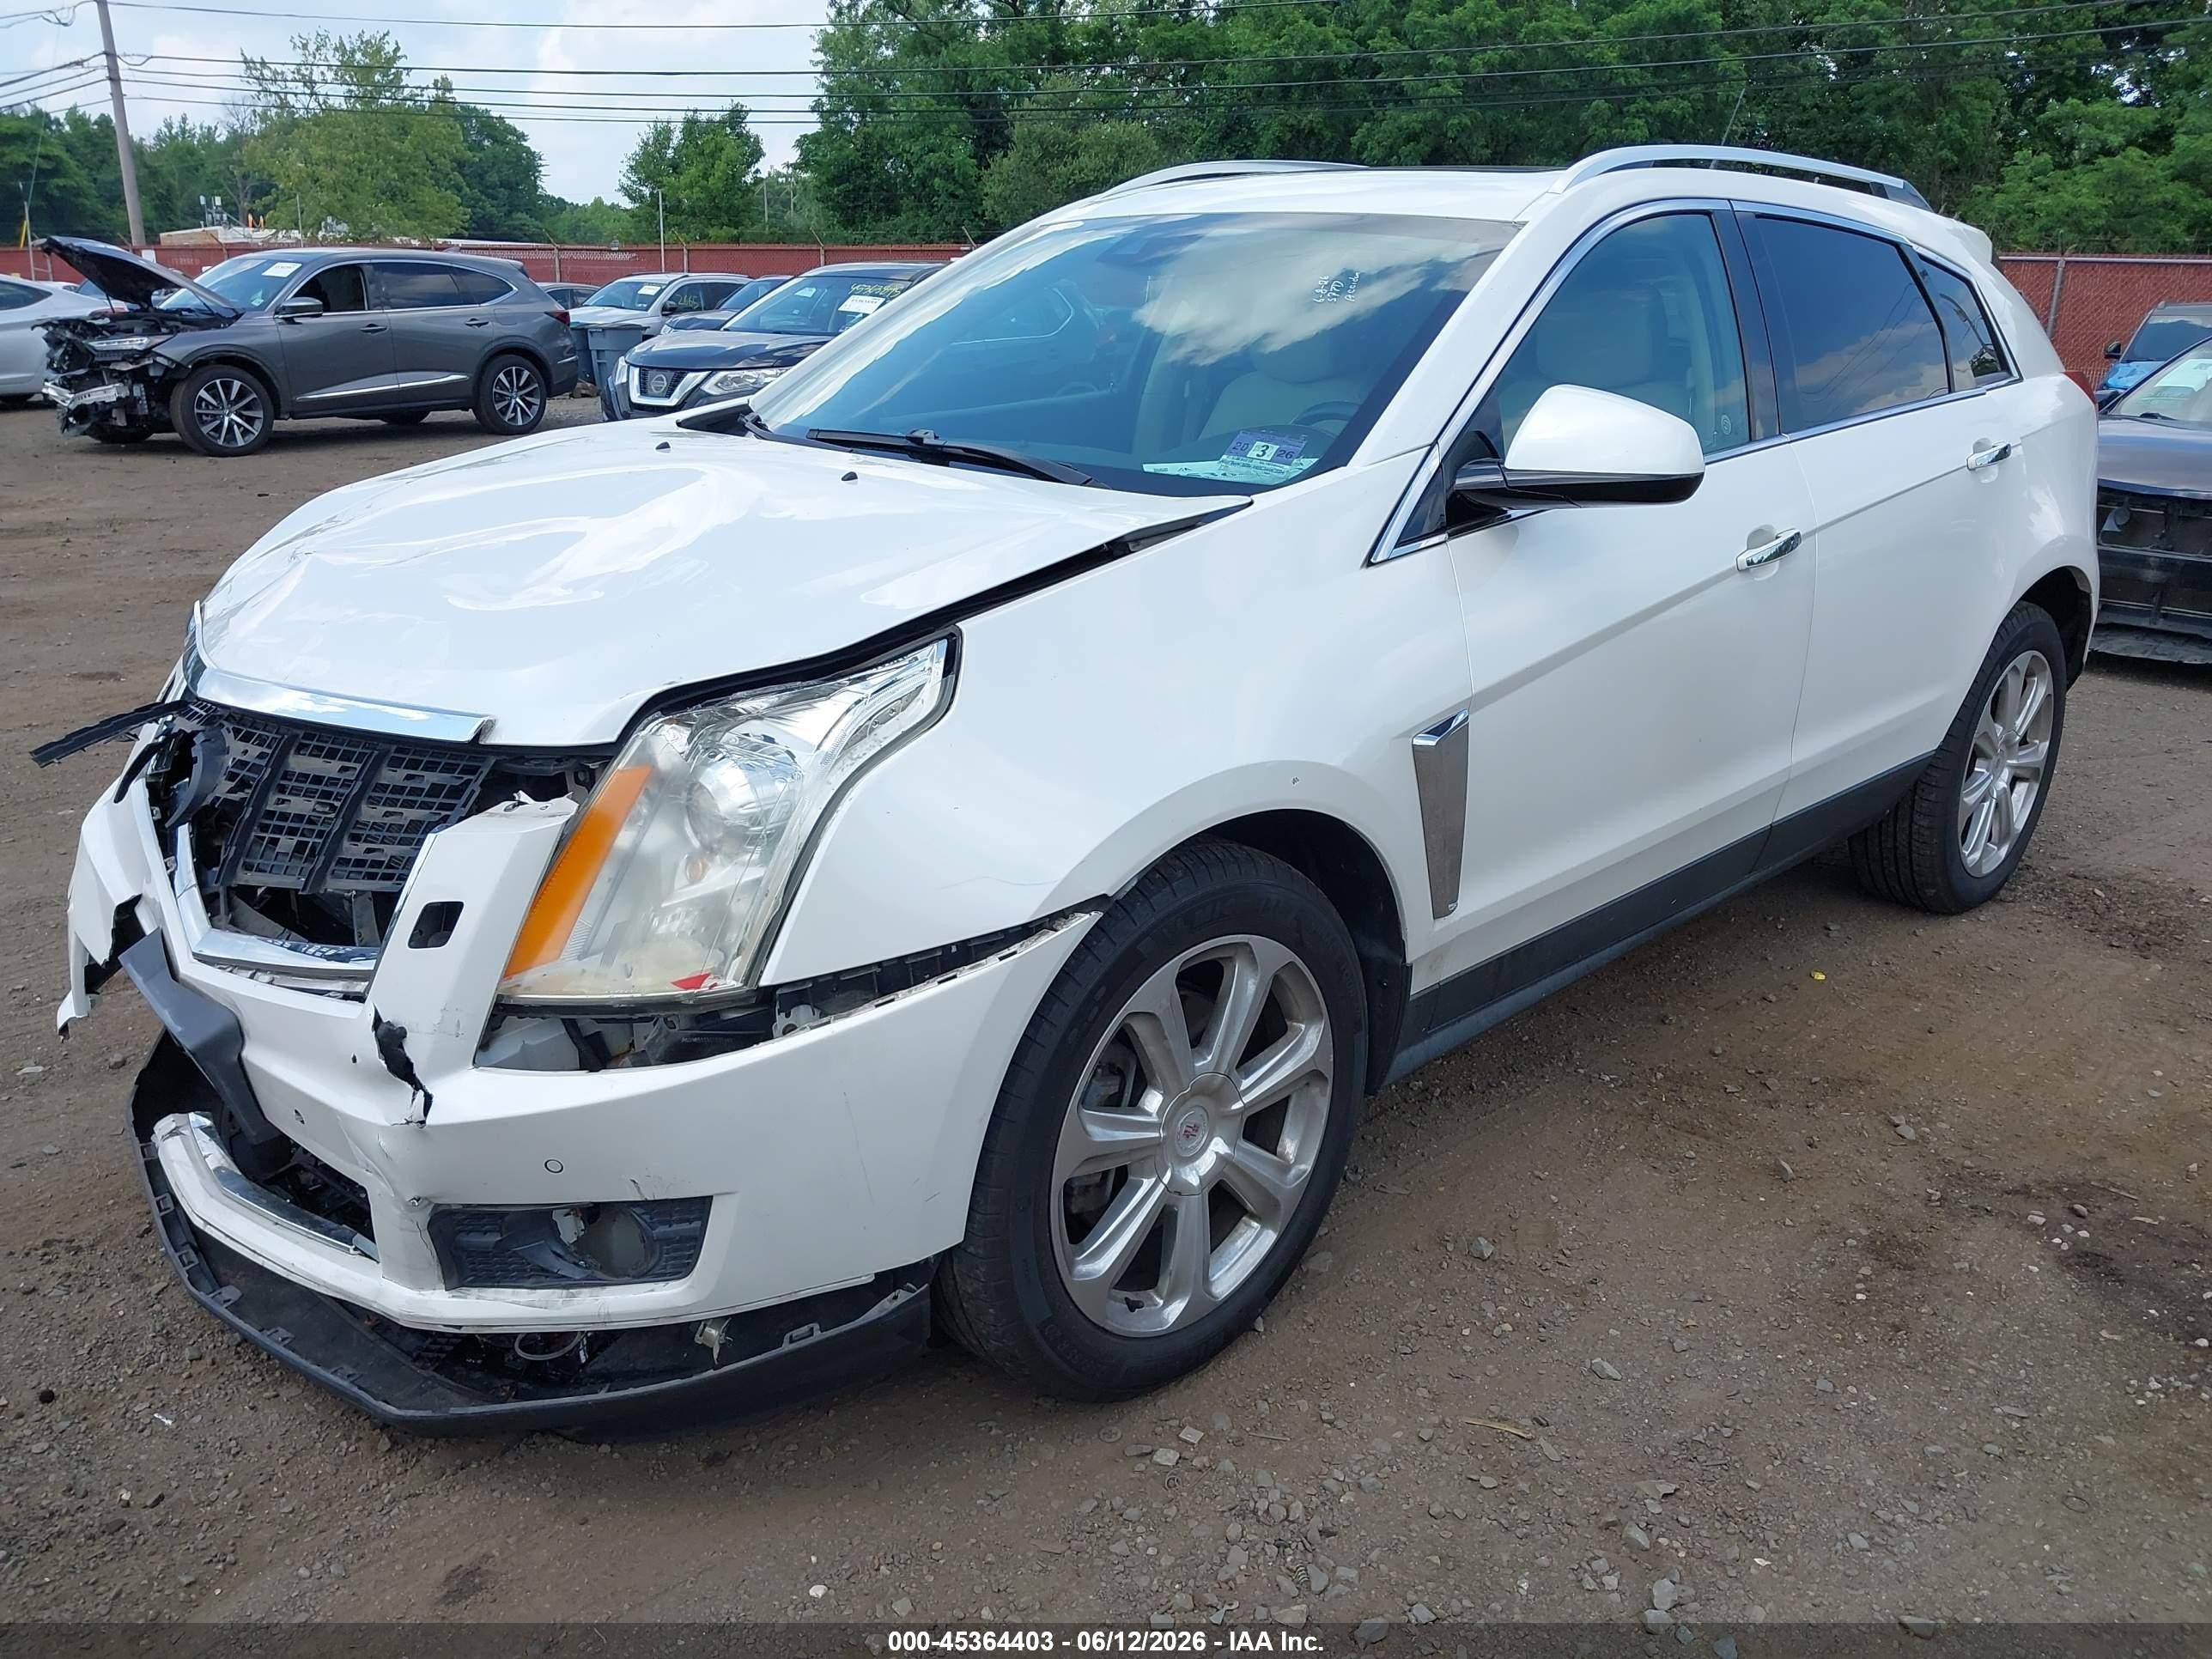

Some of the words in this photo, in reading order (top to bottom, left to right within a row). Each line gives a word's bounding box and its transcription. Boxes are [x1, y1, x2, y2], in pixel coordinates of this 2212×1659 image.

[1231, 441, 1249, 452] 20
[1256, 444, 1270, 458] 3
[1276, 449, 1295, 459] 26
